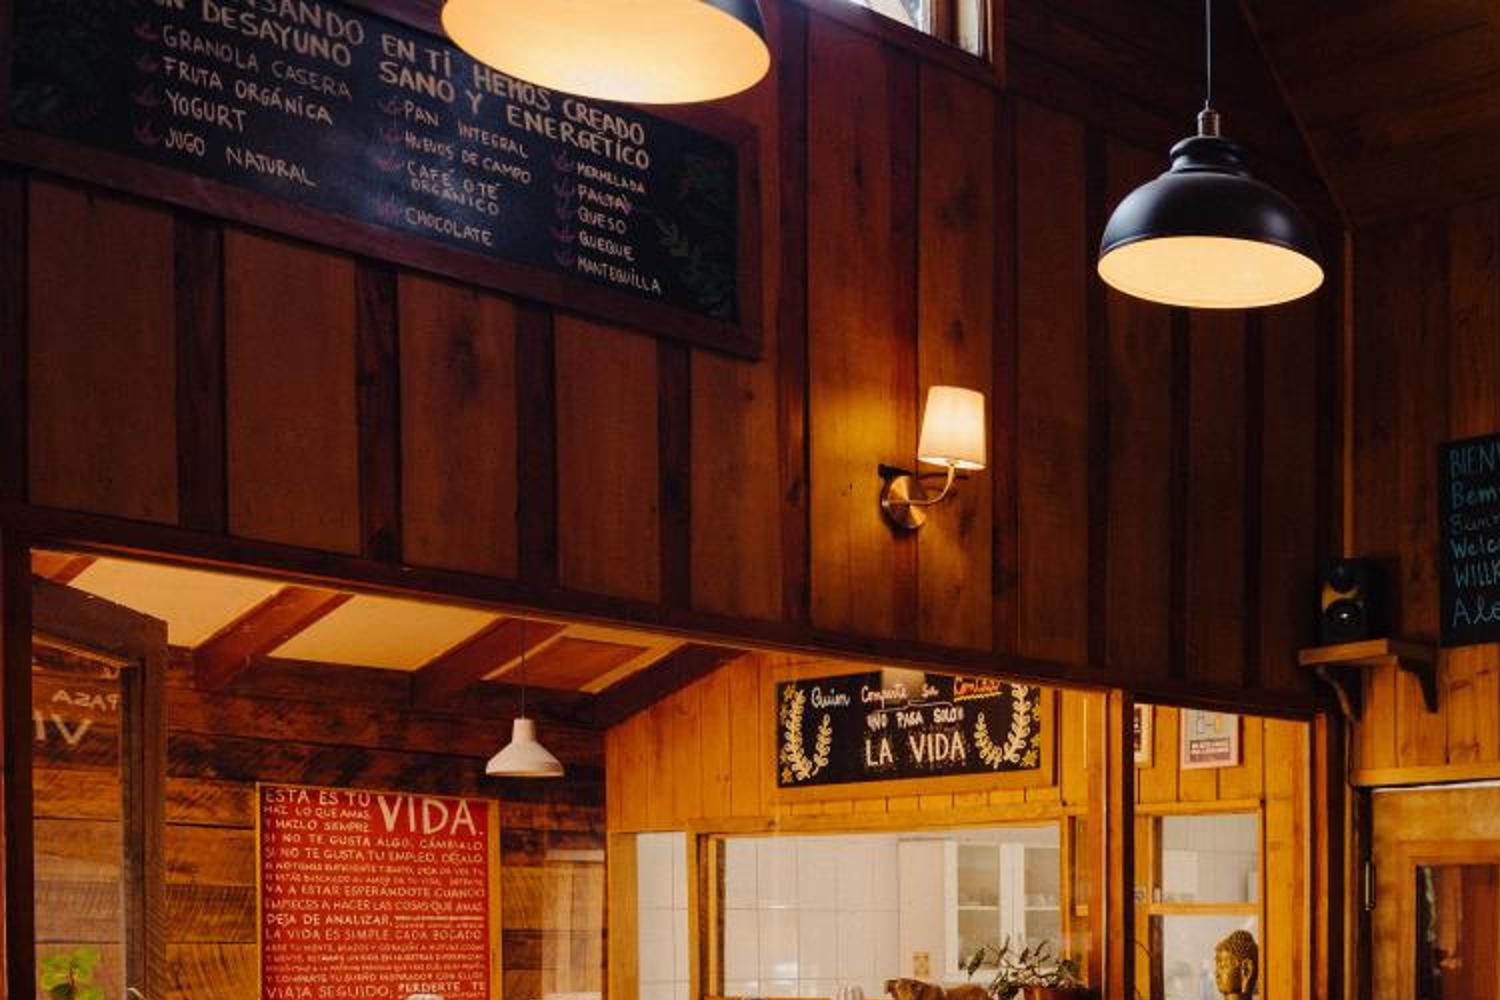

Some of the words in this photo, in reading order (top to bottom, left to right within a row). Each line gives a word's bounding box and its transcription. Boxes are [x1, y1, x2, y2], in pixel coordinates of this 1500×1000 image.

[162, 25, 259, 72] GRANOLA
[271, 60, 353, 101] CASERA
[162, 56, 224, 91] FRUTA
[203, 2, 352, 67] DESAYUNO
[378, 61, 455, 103] SANO
[465, 89, 483, 116] Y
[381, 33, 417, 63] EN
[473, 63, 552, 112] HEMOS
[563, 99, 646, 147] CREADO
[165, 88, 247, 133] YOGURT
[404, 101, 439, 127] PAN
[457, 119, 530, 159] INTEGRAL
[164, 127, 206, 157] JUGO
[225, 146, 319, 188] NATURAL
[461, 149, 479, 167] DE
[482, 157, 532, 185] CAMPO
[404, 206, 494, 247] CHOCOLATE
[576, 207, 628, 235] QUESO
[896, 711, 924, 729] PASA
[865, 736, 894, 767] LA
[909, 731, 967, 765] VIDA
[265, 787, 311, 804] ESTA
[319, 790, 339, 806] ES
[343, 790, 371, 808] TU
[275, 819, 318, 831] HAZLO
[295, 807, 313, 817] LO
[314, 807, 338, 820] QUE
[280, 847, 300, 858] NO
[305, 847, 321, 859] TE
[323, 849, 365, 862] GUSTA
[367, 851, 386, 862] TU
[282, 833, 301, 844] NO
[308, 833, 323, 845] TE
[329, 835, 372, 848] GUSTA
[287, 884, 297, 896] A
[265, 927, 282, 940] LA
[287, 928, 321, 941] VIDA
[324, 928, 341, 941] ES
[302, 912, 321, 926] DE
